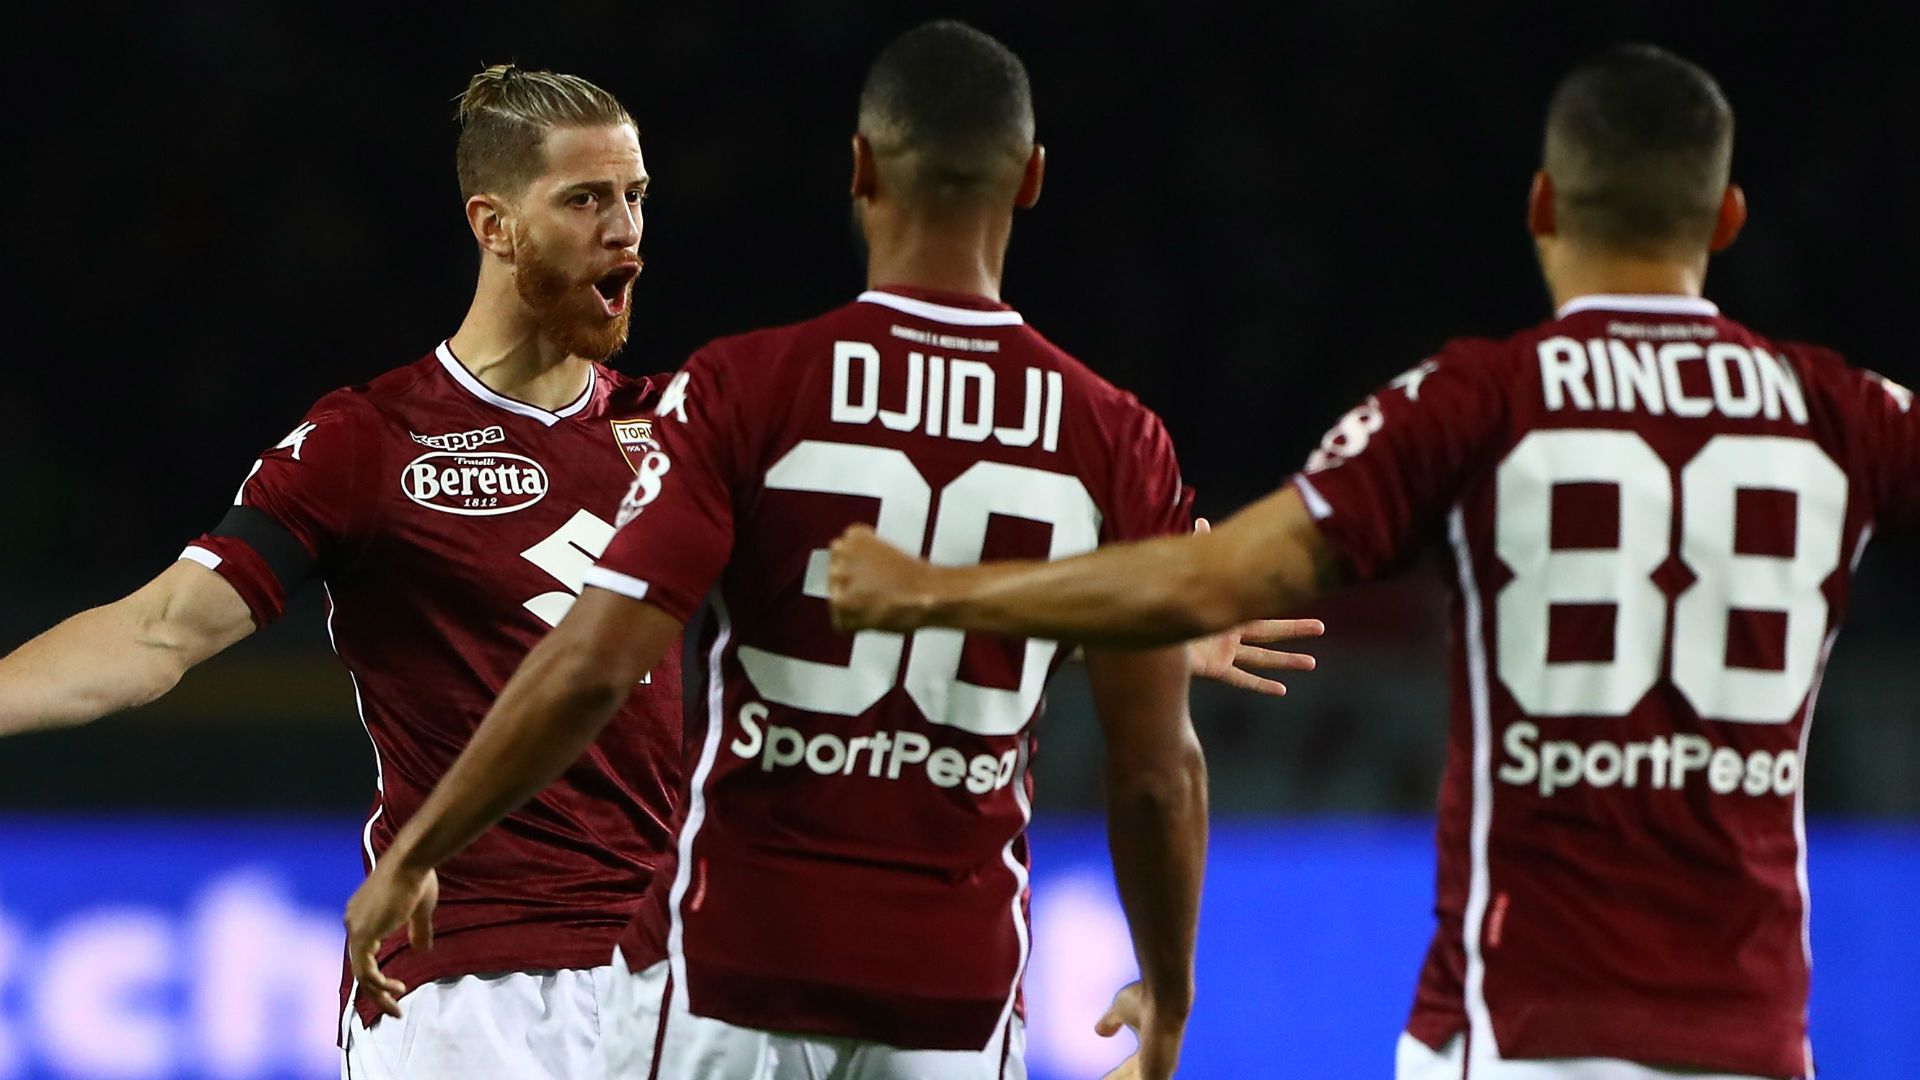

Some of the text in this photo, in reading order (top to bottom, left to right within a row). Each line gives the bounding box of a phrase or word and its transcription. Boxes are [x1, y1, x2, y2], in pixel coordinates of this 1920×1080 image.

[831, 340, 1063, 453] DJIDJI
[1537, 337, 1808, 425] RINCON
[411, 463, 545, 500] Beretta
[454, 457, 496, 466] Fratelli
[463, 498, 498, 507] 1812
[737, 440, 1101, 735] 30
[1494, 429, 1849, 724] 88
[1499, 720, 1800, 796] SportPeso
